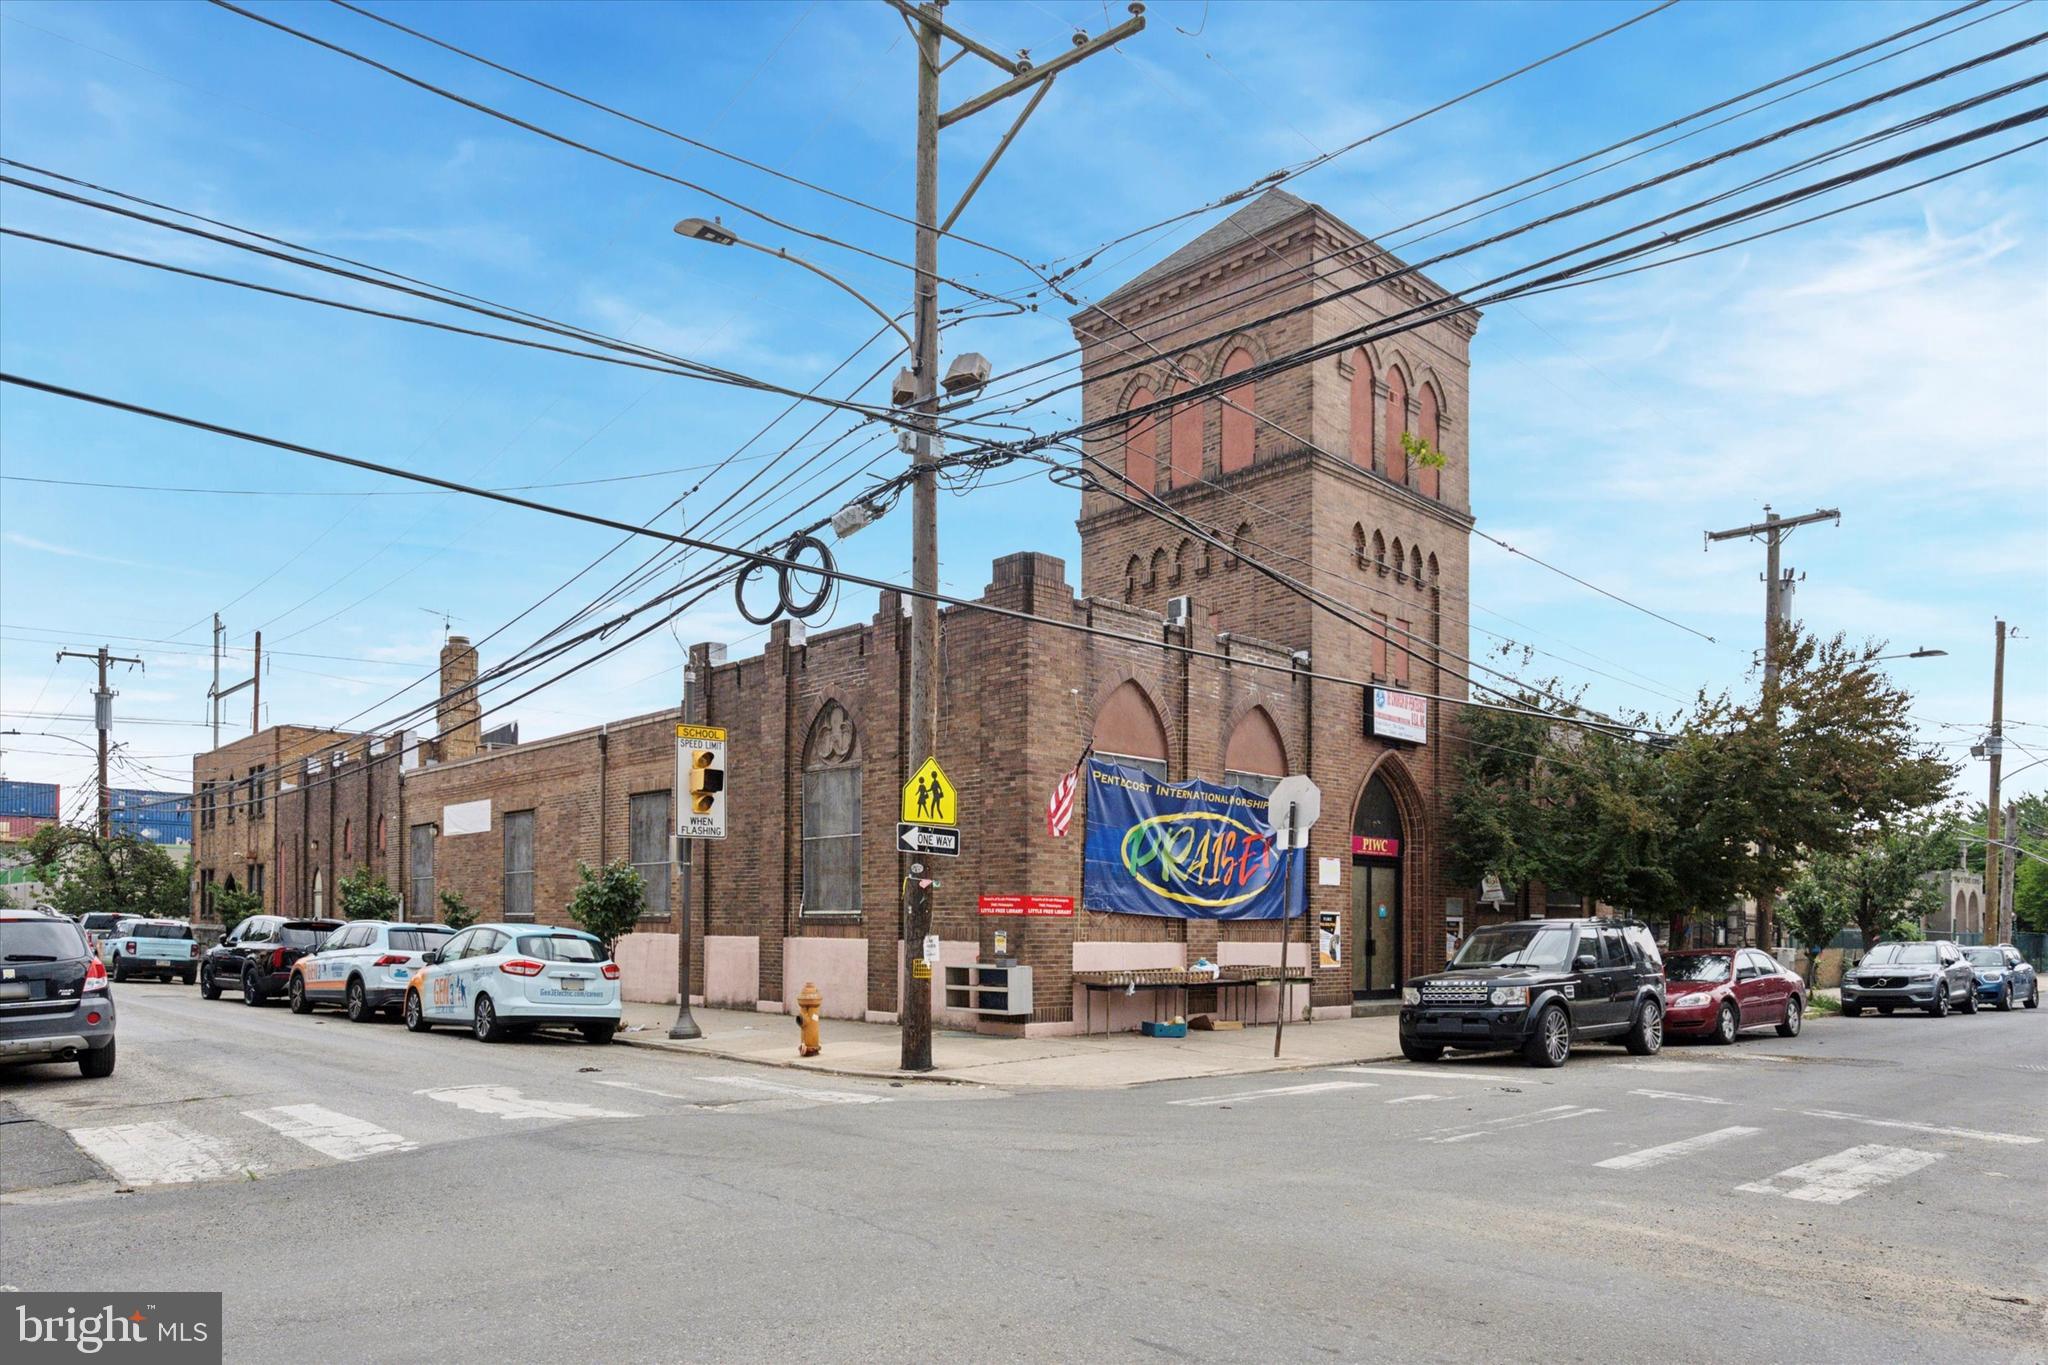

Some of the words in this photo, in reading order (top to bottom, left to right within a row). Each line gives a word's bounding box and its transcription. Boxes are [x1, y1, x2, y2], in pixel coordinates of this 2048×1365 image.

[683, 727, 720, 739] SCHOOL
[680, 739, 703, 749] SPEED
[705, 740, 722, 750] LIMIT
[690, 817, 713, 826] WHEN
[681, 826, 722, 836] FLASHING
[917, 833, 934, 845] ONE
[935, 836, 953, 847] WAY
[1362, 837, 1389, 852] PIWC
